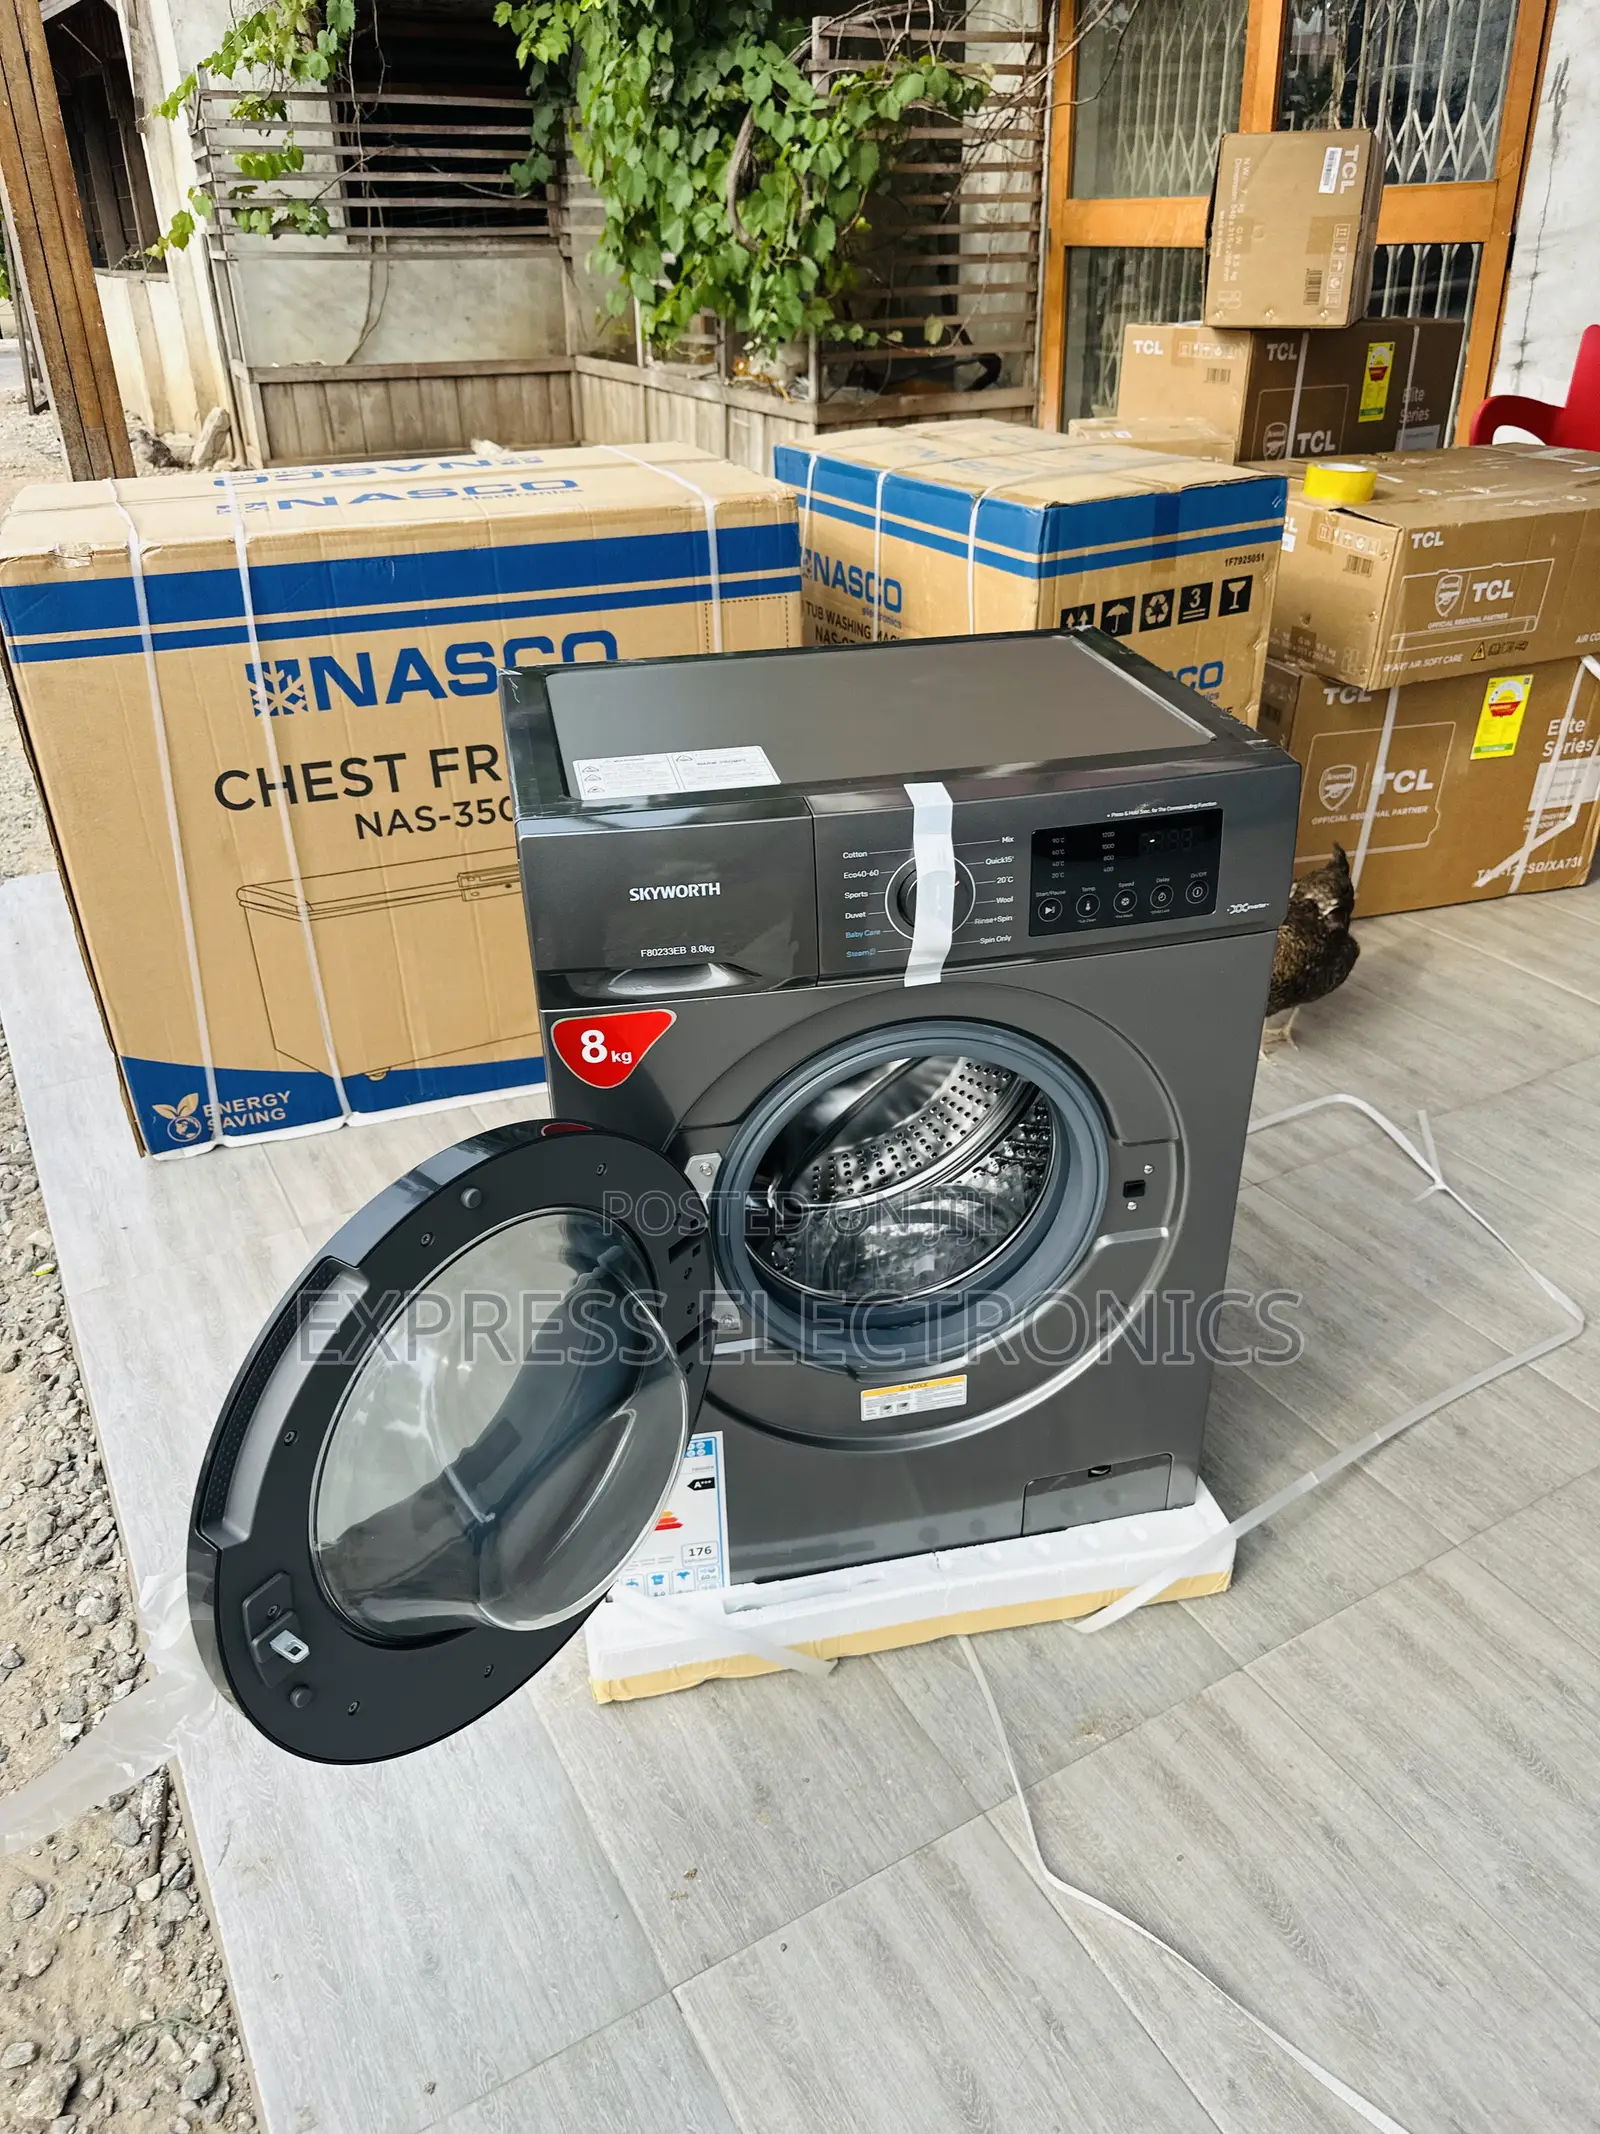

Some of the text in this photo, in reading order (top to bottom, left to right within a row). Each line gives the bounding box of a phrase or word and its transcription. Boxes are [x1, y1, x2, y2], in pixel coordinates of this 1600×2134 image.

[1339, 144, 1360, 194] TCL
[1133, 340, 1164, 355] TCL
[1266, 342, 1297, 361] TCL
[1297, 430, 1336, 455] TCL
[276, 479, 580, 511] NASCO
[1411, 531, 1445, 549] TCL
[814, 551, 903, 614] NASCO
[1472, 579, 1514, 603] TCL
[805, 601, 824, 621] TUB
[825, 609, 872, 640] WASHING
[1322, 686, 1372, 706] TCL
[1546, 718, 1586, 736] Ete
[1542, 738, 1595, 757] Sries
[214, 752, 407, 811] CHEST
[1311, 813, 1349, 825] OFFICIAL
[1391, 805, 1429, 816] PARTNER
[842, 850, 868, 859] Cotton
[843, 869, 880, 880] Eco40-60
[1190, 871, 1207, 879] On/Off
[628, 882, 721, 902] SKYWORTH
[844, 890, 868, 900] Sports
[996, 896, 1014, 904] Wool
[845, 911, 866, 920] Duvet
[974, 915, 1013, 925] Rinse+Spin
[845, 928, 881, 940] Baby Care
[979, 934, 1012, 945] Spin Only
[640, 945, 715, 957] F80233EB 8.0kg
[846, 949, 869, 958] Steam
[580, 1029, 633, 1065] 8 kg
[202, 1090, 291, 1118] ENERGY
[206, 1108, 287, 1131] SAVING
[688, 1545, 712, 1557] 176
